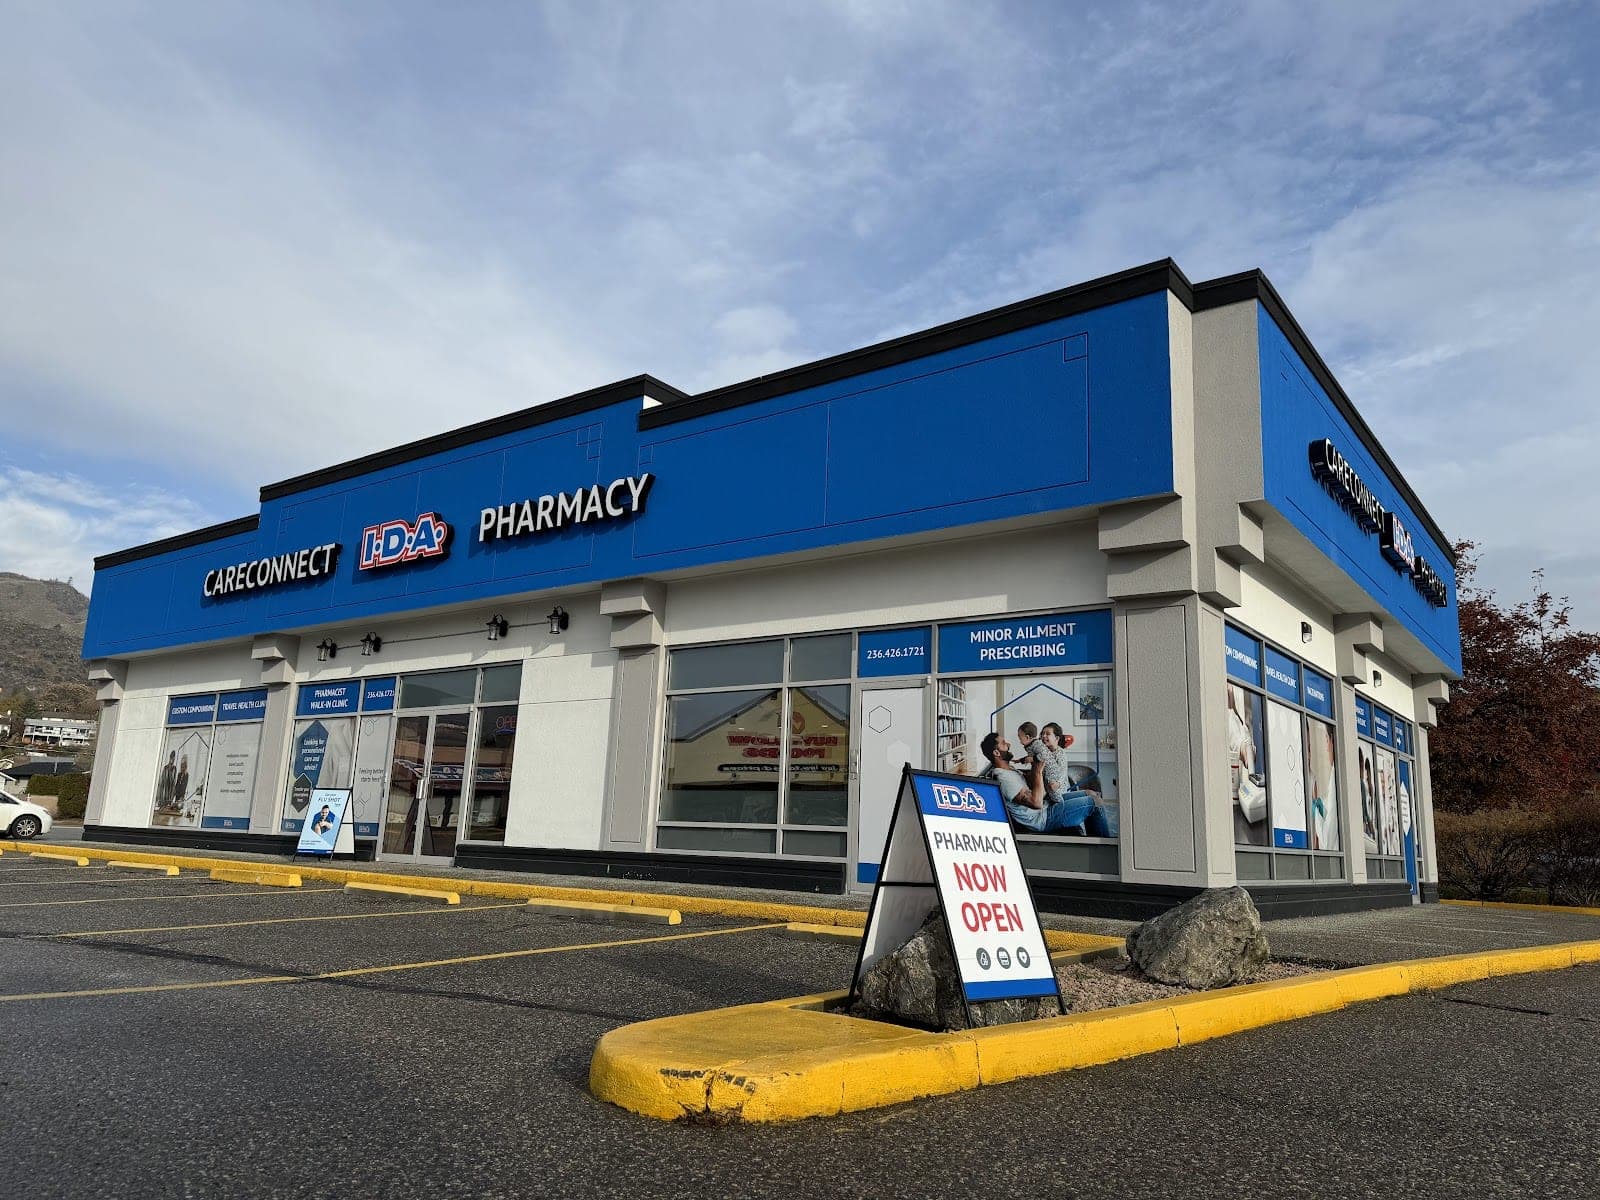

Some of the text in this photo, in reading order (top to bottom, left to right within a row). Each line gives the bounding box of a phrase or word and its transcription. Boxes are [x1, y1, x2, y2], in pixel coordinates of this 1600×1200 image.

[1325, 437, 1386, 534] CARECONNECT
[203, 542, 337, 597] CARECONNECT
[478, 473, 649, 542] PHARMACY
[970, 622, 1077, 644] MINOR AILMENT
[867, 646, 925, 659] 236.426.1721
[980, 642, 1067, 661] PRESCRIBING
[314, 687, 347, 699] PHARMACIST
[222, 702, 238, 711] TRAVEL
[238, 701, 254, 709] HEALTH
[310, 699, 349, 710] WALK-IN CLINIC
[496, 716, 516, 729] OPE
[934, 831, 1008, 855] PHARMACY
[953, 862, 1008, 893] NOW
[961, 901, 1024, 932] OPEN
